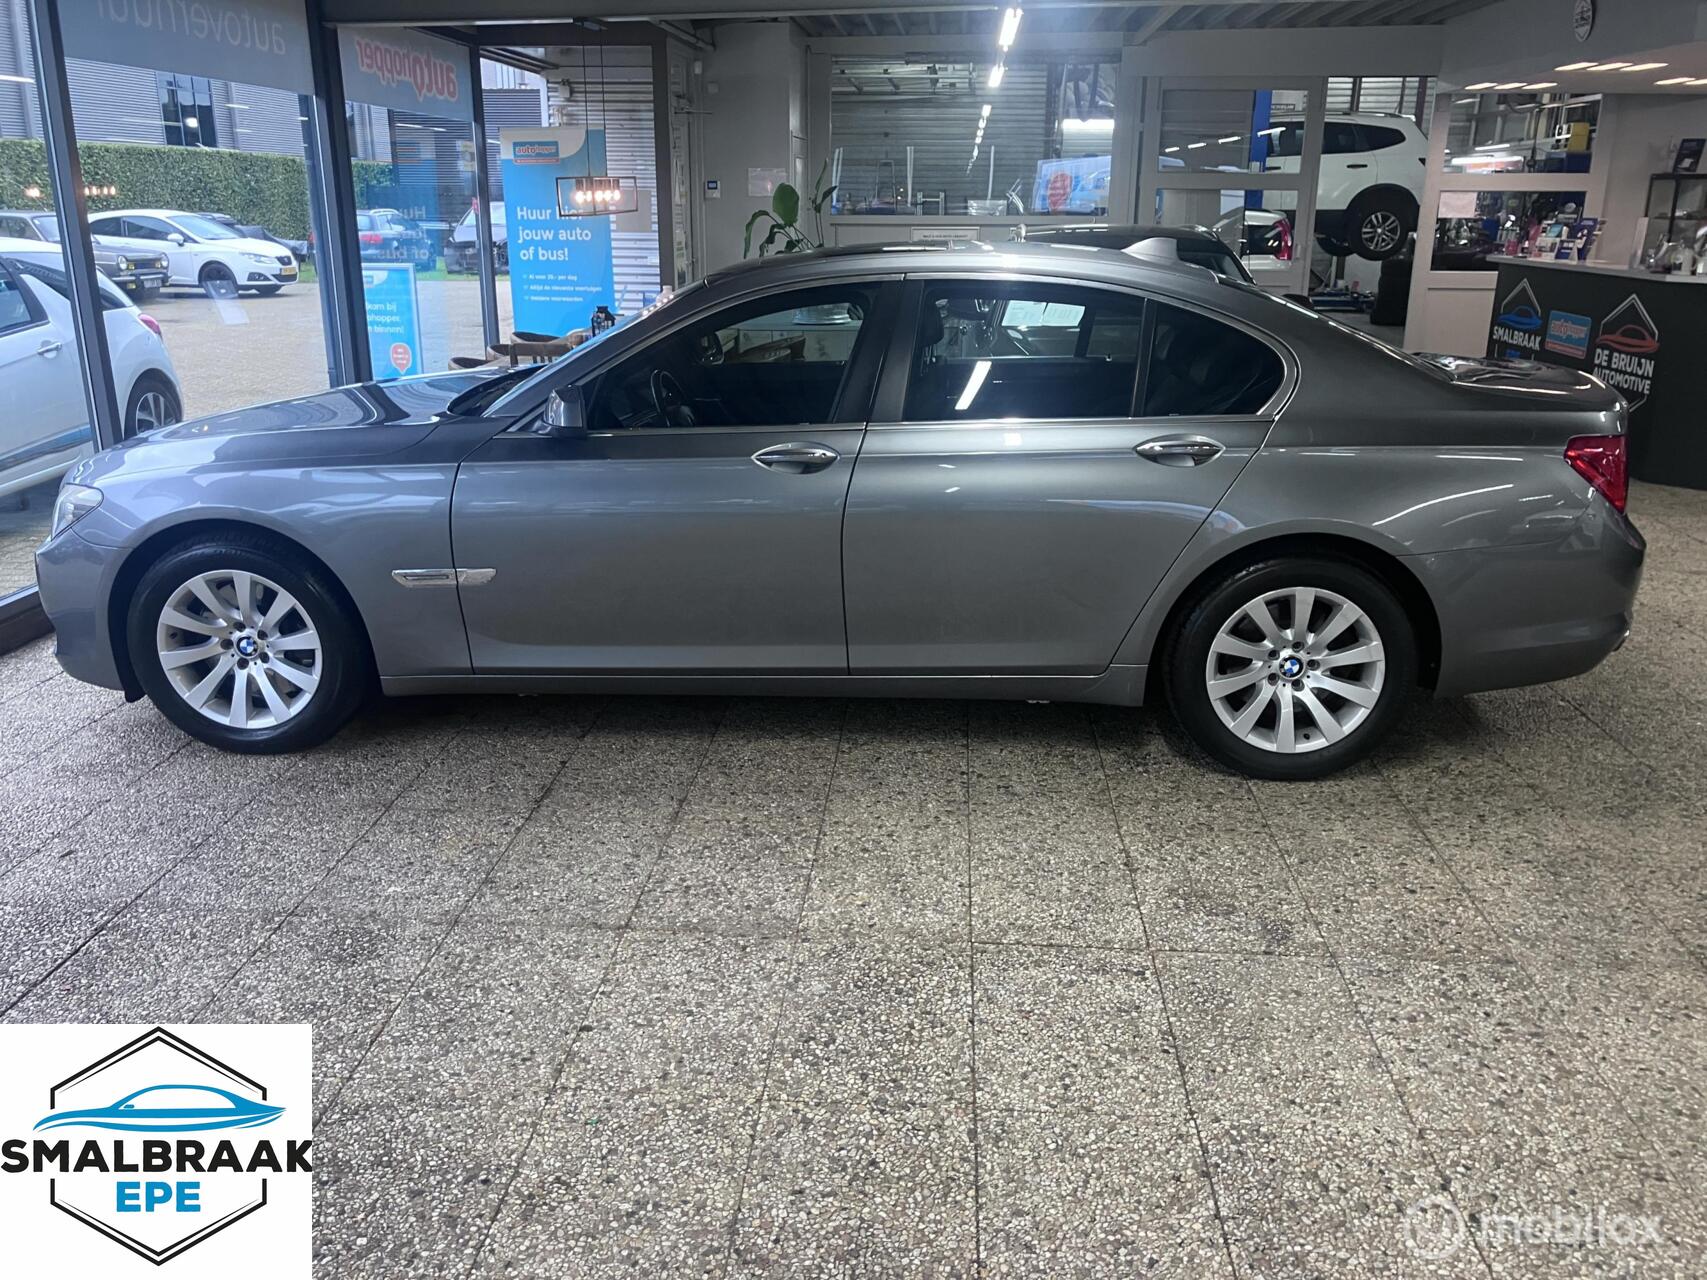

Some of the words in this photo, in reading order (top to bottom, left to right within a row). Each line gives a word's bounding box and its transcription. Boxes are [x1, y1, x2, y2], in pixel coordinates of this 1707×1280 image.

[517, 206, 551, 220] Huur
[517, 226, 554, 244] jouw
[558, 227, 592, 241] auto
[520, 246, 535, 261] of
[538, 246, 569, 261] bus!
[1493, 326, 1542, 352] SMALBRAAK
[1594, 348, 1609, 365] DE
[1611, 352, 1655, 378] BRUIJN
[1592, 367, 1651, 394] AUTOMOTIVE
